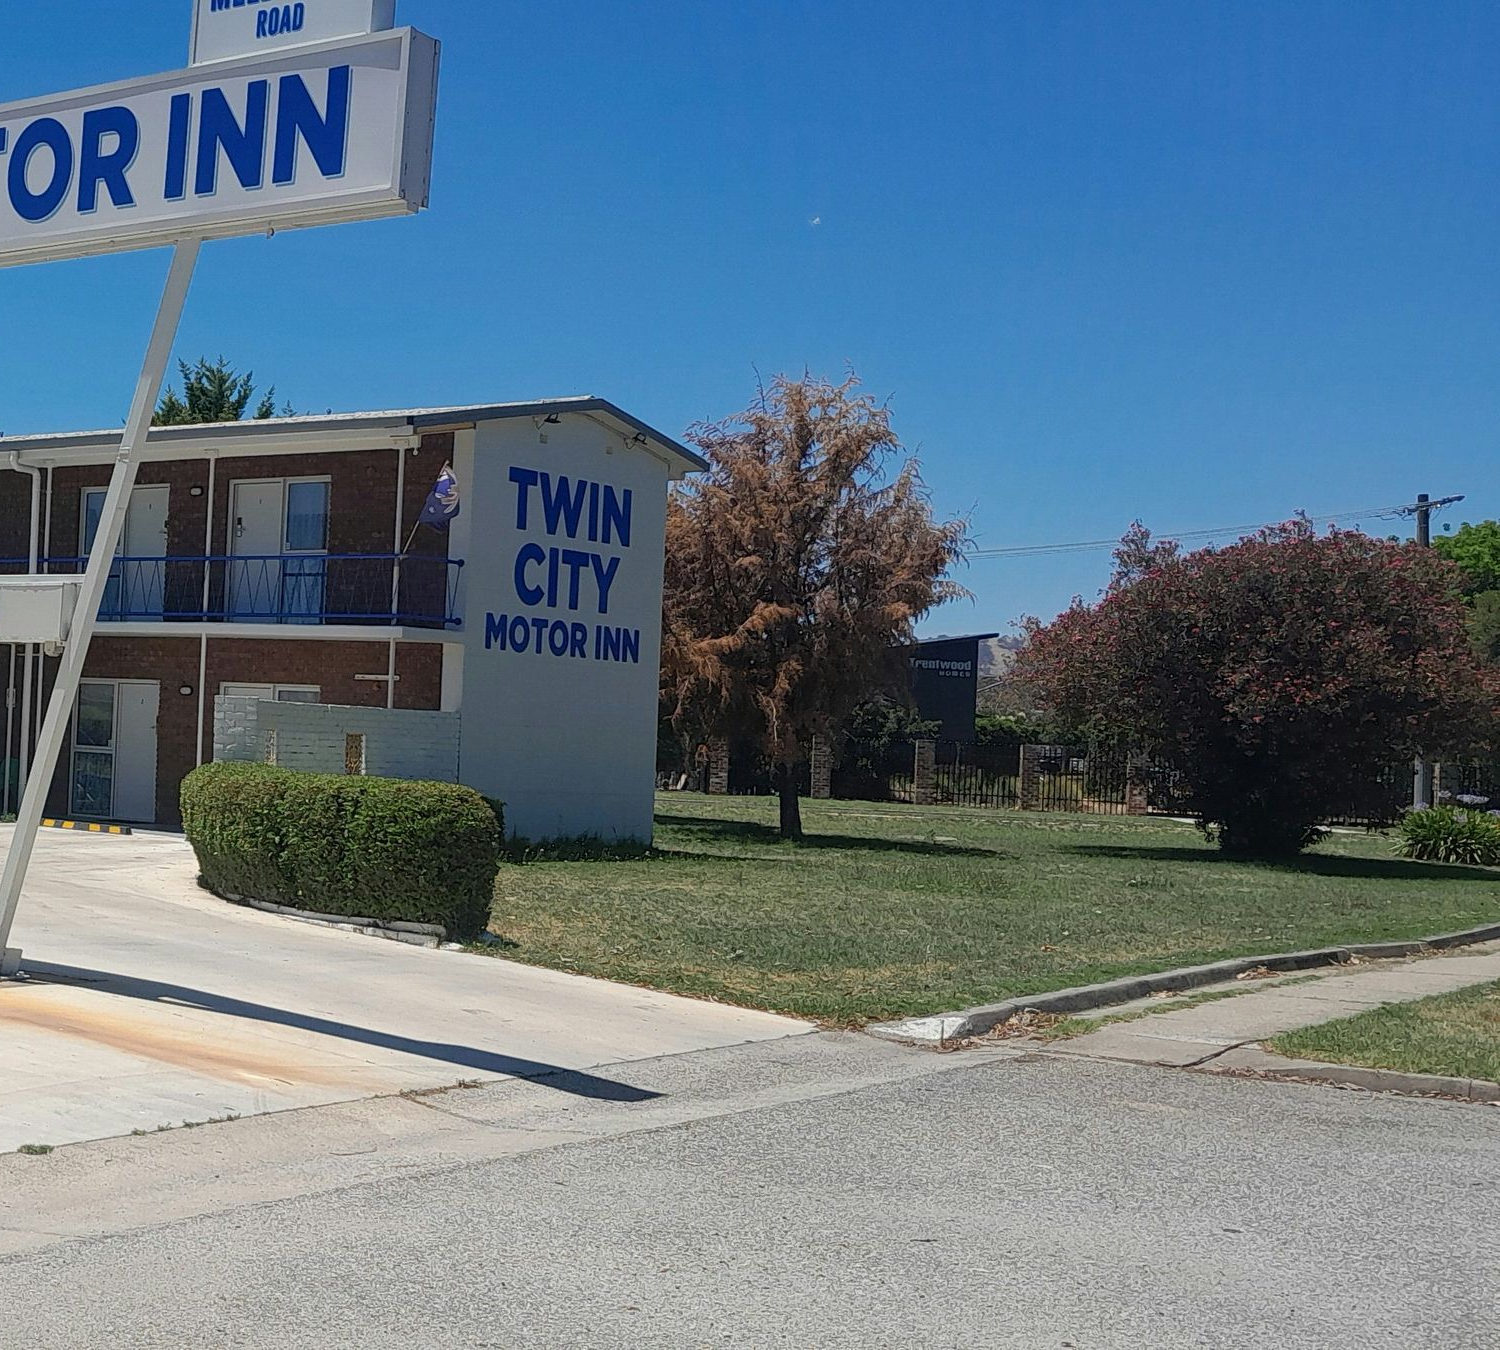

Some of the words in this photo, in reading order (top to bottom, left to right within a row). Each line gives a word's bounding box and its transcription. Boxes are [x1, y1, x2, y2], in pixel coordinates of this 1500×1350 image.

[256, 2, 305, 38] ROAD
[164, 64, 352, 200] INN
[508, 465, 633, 548] TWIN
[514, 542, 621, 614] CITY
[484, 611, 588, 659] MOTOR
[594, 624, 640, 664] INN
